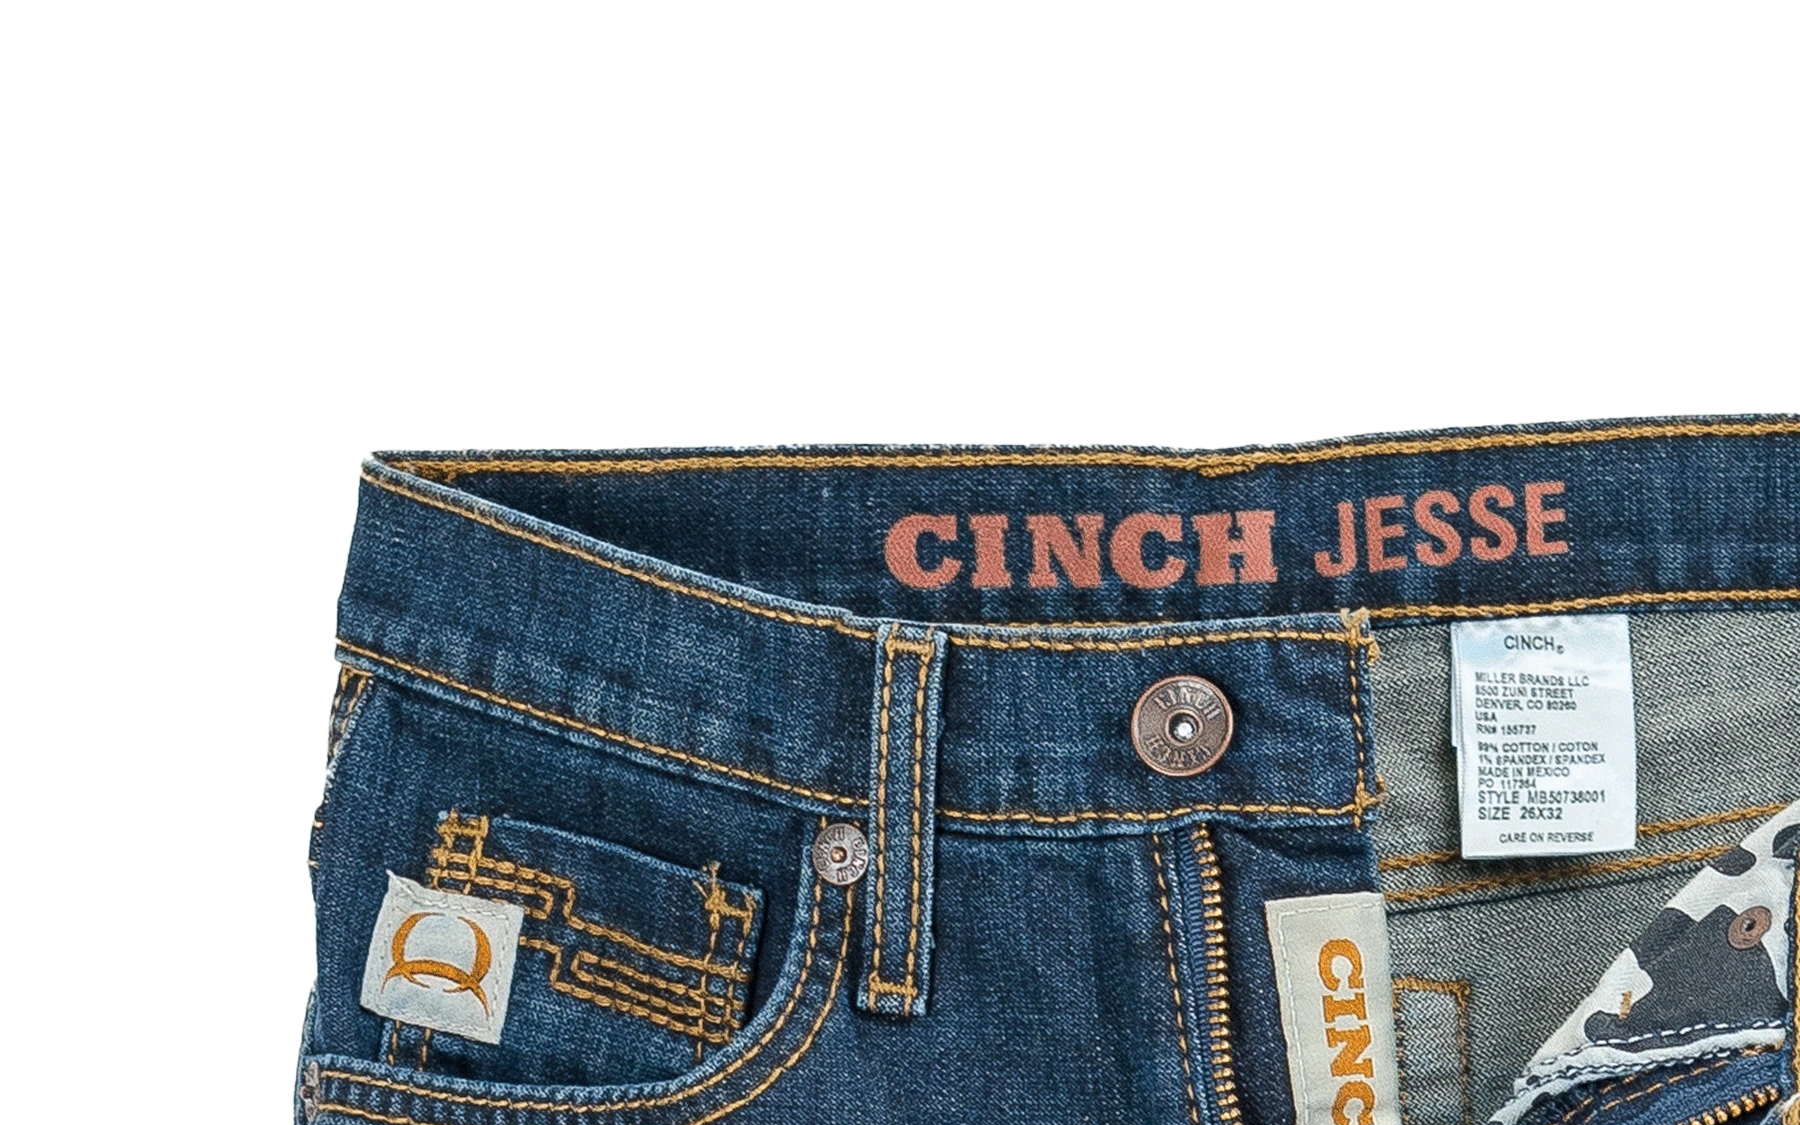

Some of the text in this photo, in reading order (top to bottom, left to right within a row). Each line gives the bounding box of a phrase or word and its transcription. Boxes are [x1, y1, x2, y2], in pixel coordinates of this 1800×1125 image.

[884, 481, 1570, 589] CINCH JESSE
[1475, 671, 1590, 688] MILLER BRANDS LLC
[1501, 686, 1528, 698] ZUNI
[1530, 687, 1574, 700] STREET
[1526, 700, 1544, 711] CO
[1475, 711, 1498, 723] USA
[1502, 742, 1549, 753] COTTON
[1558, 741, 1599, 752] COTON
[1496, 754, 1546, 766] SPANDEX
[1555, 753, 1606, 765] SPANDEX
[1478, 765, 1570, 778] MADE IN MEXICO
[1478, 777, 1494, 788] PO
[1478, 790, 1520, 805] STYLE
[1478, 805, 1563, 820] SIZE 26X32
[1499, 831, 1595, 843] CARE ON REVERSE
